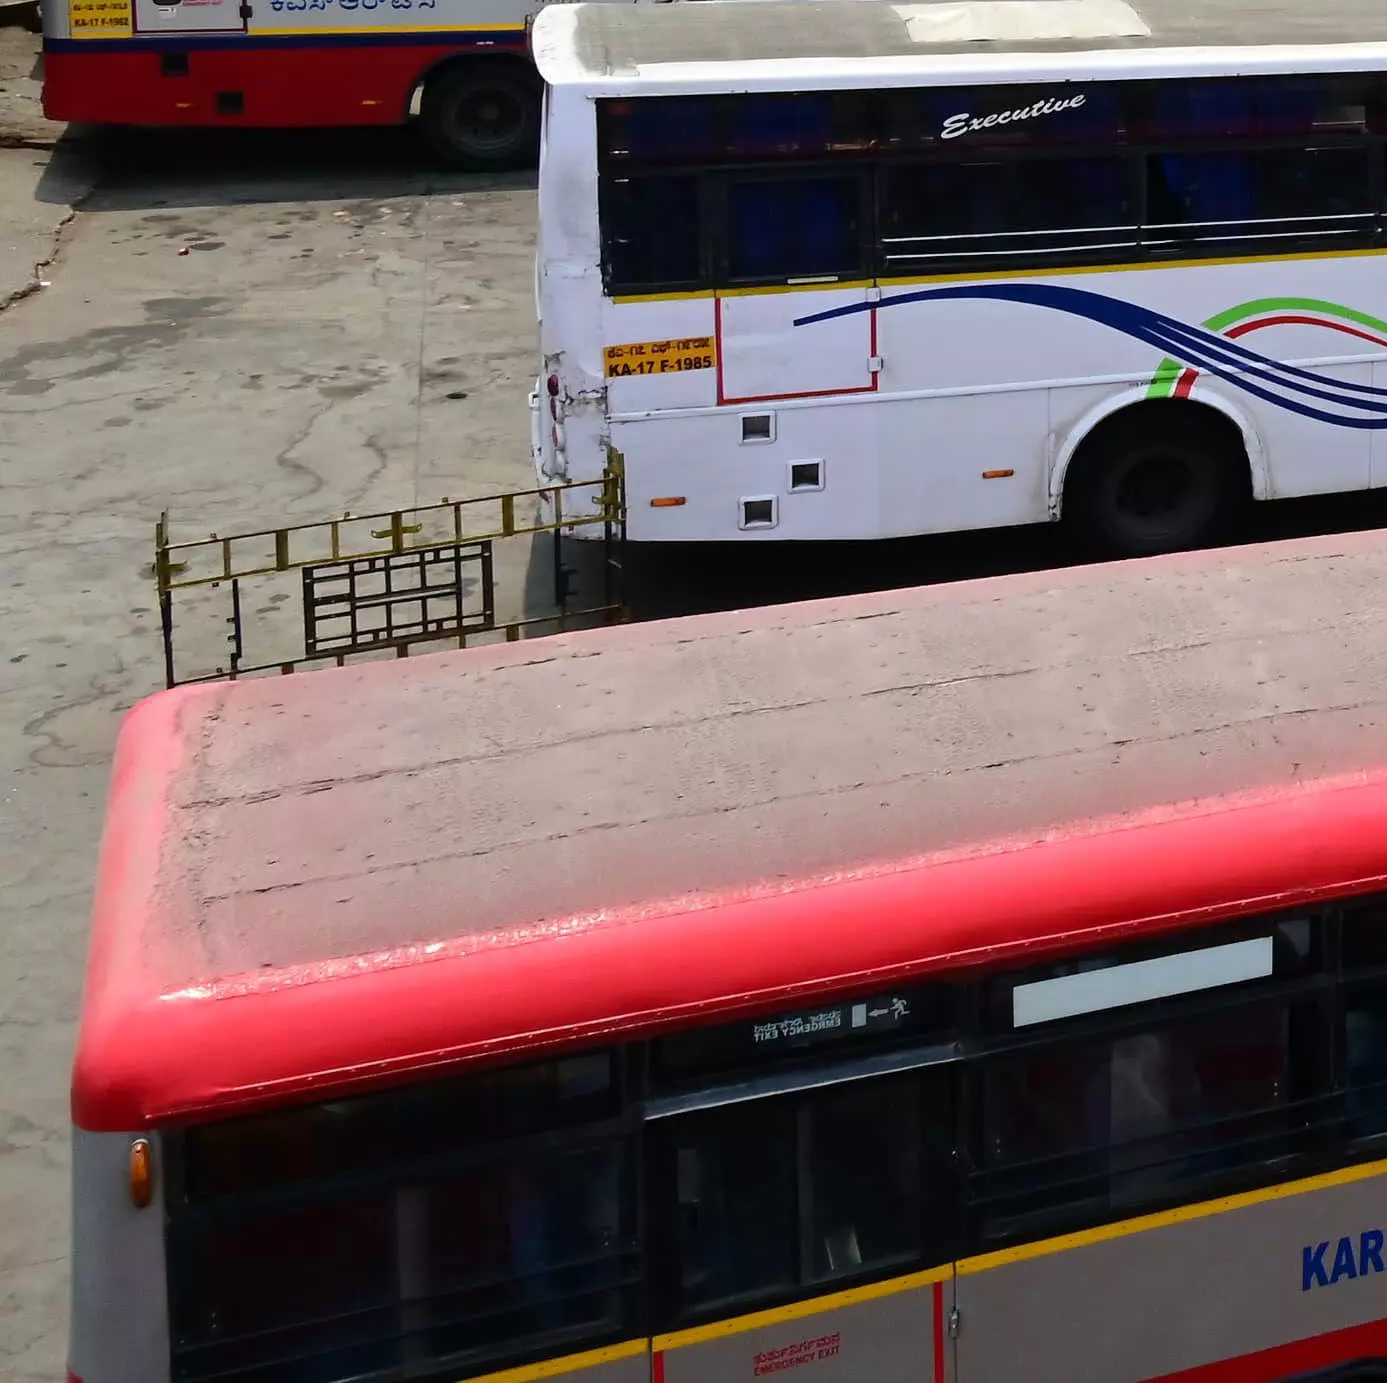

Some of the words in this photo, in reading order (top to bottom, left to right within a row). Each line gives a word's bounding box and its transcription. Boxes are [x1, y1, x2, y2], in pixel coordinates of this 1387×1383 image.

[941, 92, 1086, 139] Executive
[609, 360, 654, 377] KA-17
[660, 355, 712, 372] F-1985
